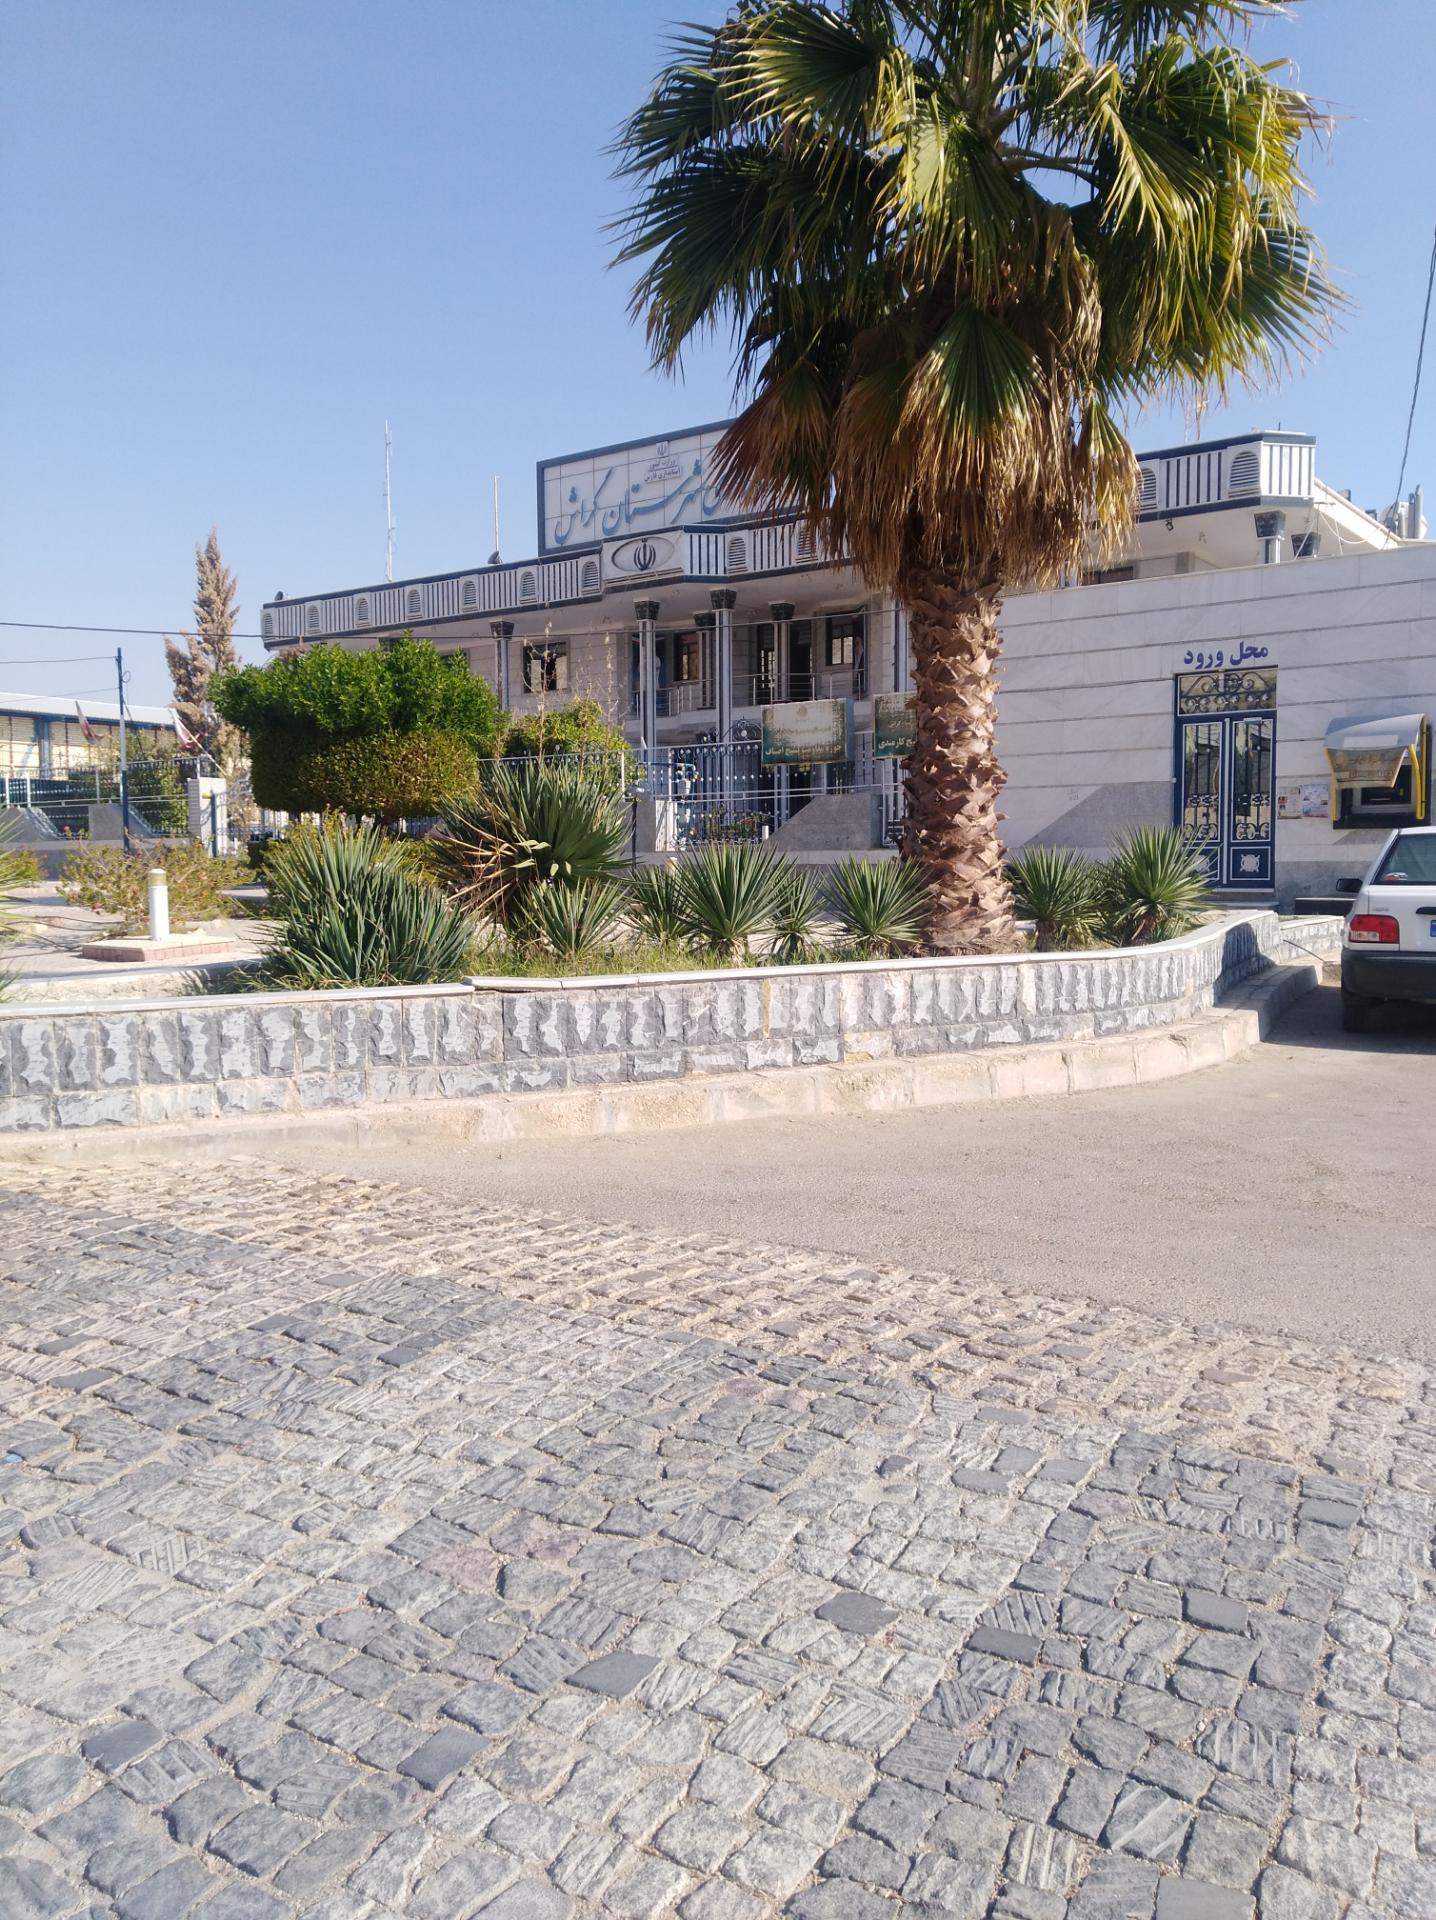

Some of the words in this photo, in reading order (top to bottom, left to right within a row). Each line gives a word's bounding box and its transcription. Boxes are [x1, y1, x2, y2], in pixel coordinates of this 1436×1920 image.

[554, 467, 613, 545] گراش
[602, 458, 703, 536] شهرستان
[1184, 651, 1224, 670] ورود
[1230, 641, 1269, 666] محل
